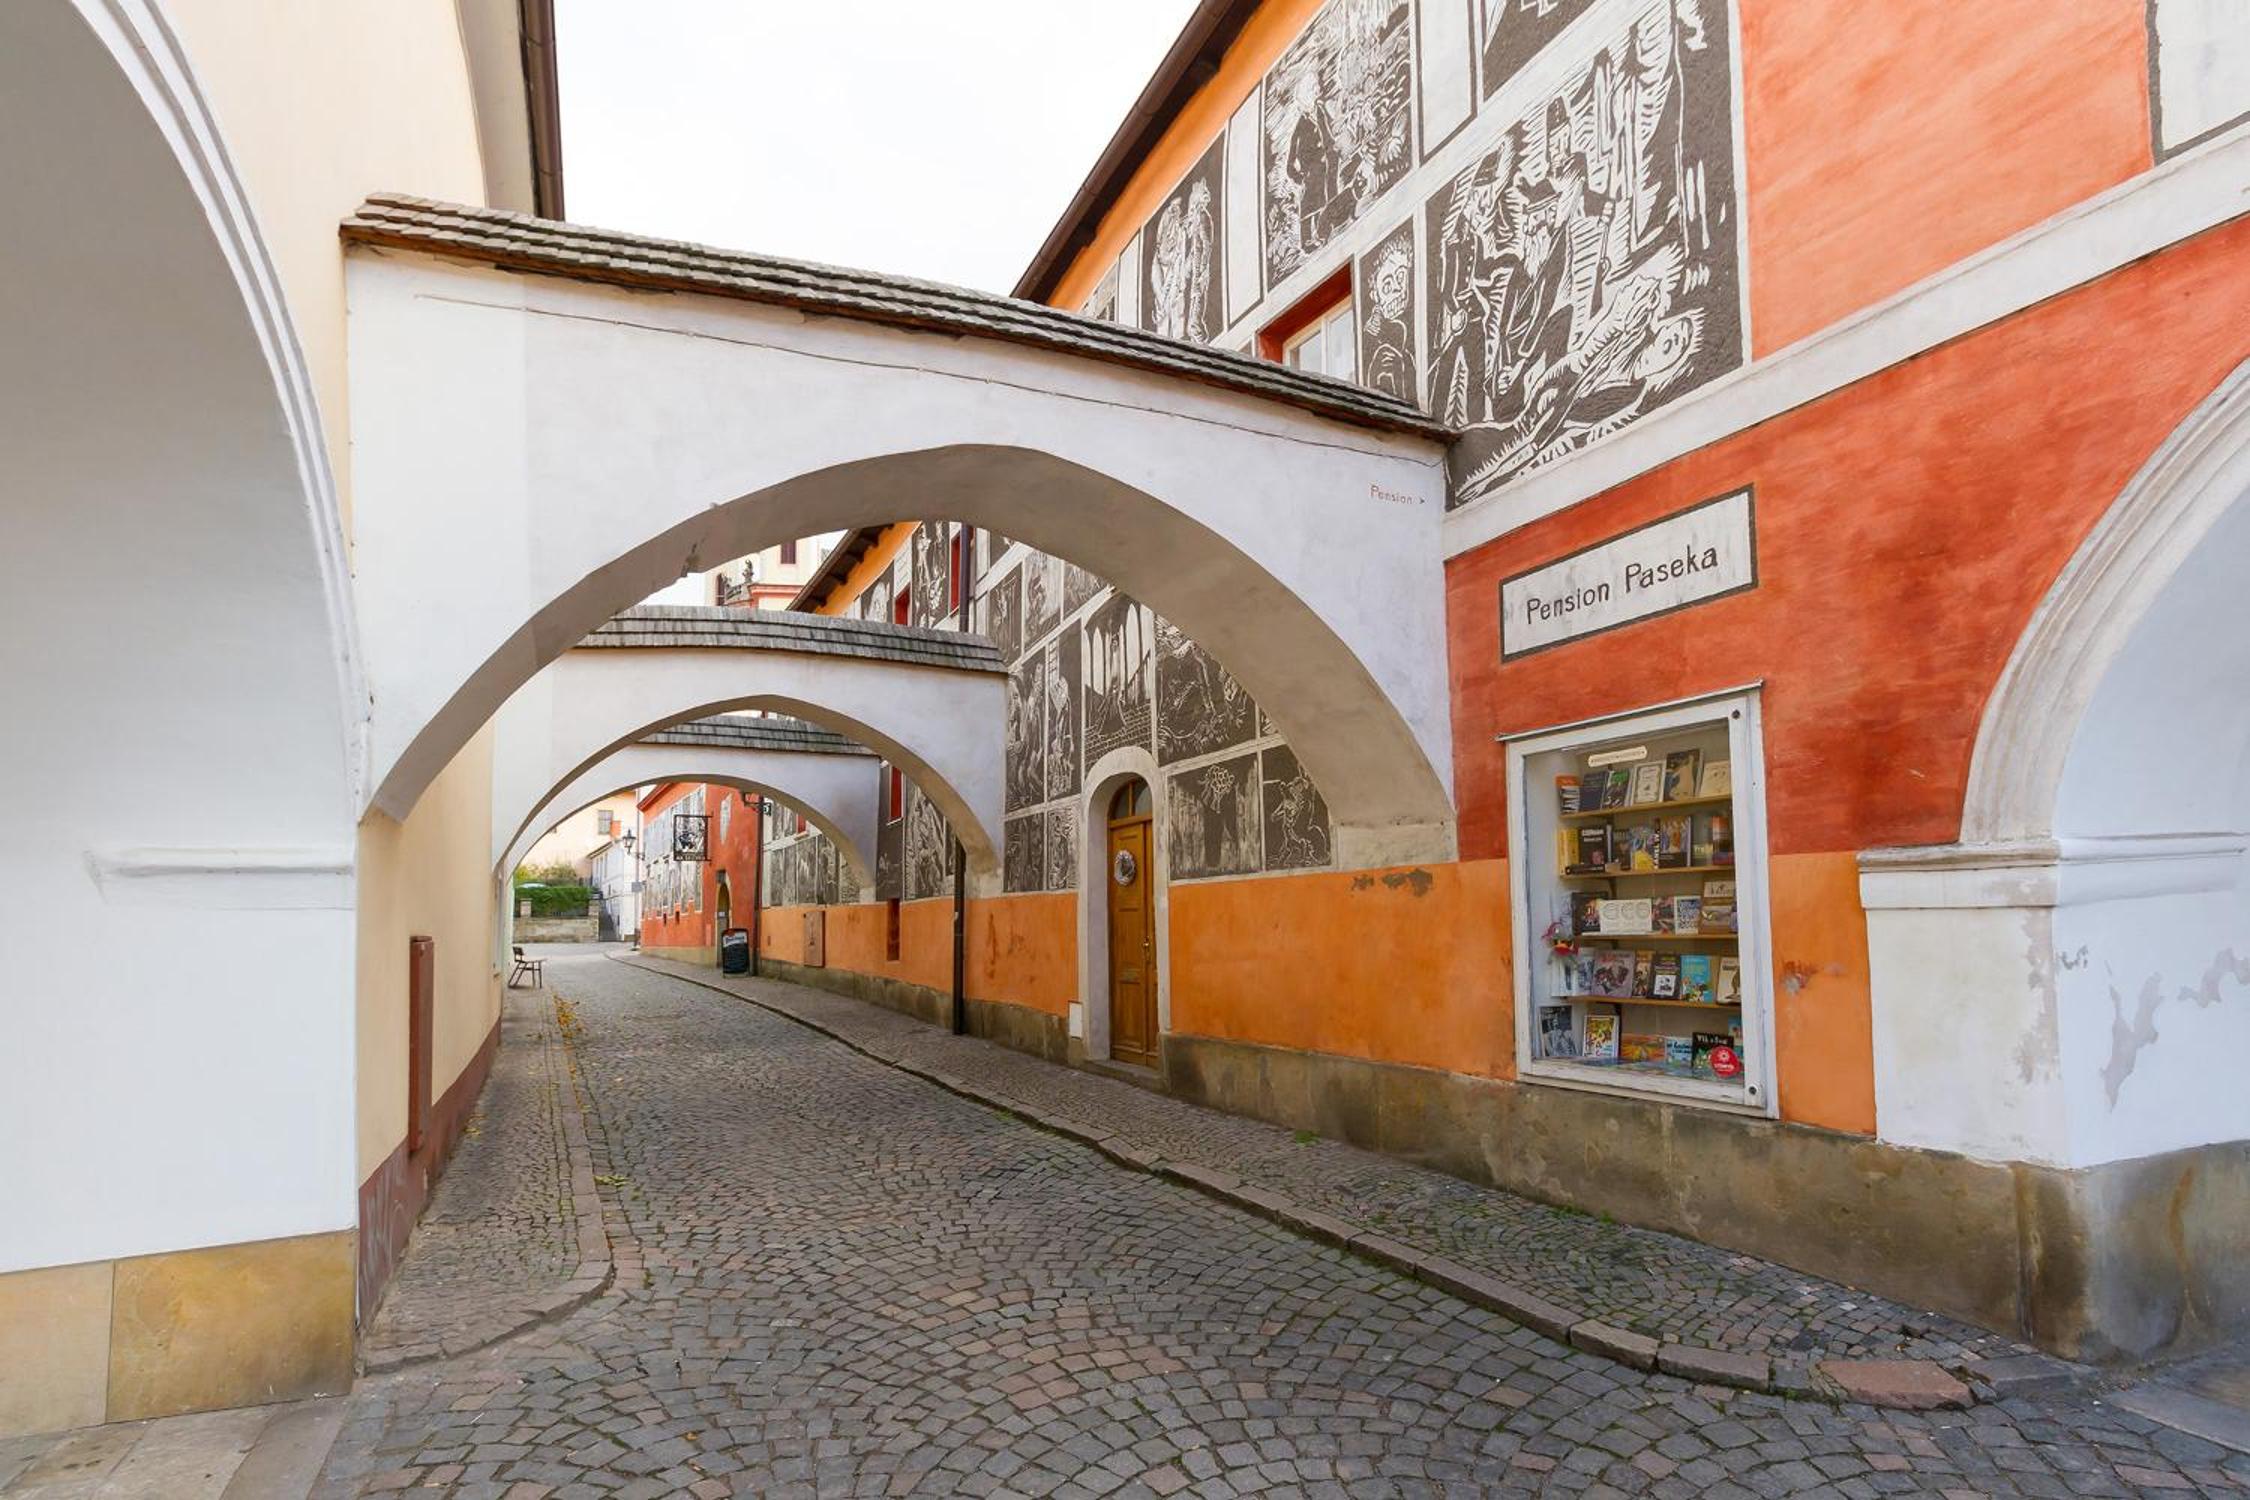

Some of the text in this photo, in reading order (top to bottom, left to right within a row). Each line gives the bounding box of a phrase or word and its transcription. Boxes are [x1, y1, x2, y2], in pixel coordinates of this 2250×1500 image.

[1370, 484, 1413, 505] Pension
[1527, 545, 1718, 624] Pension Paseka
